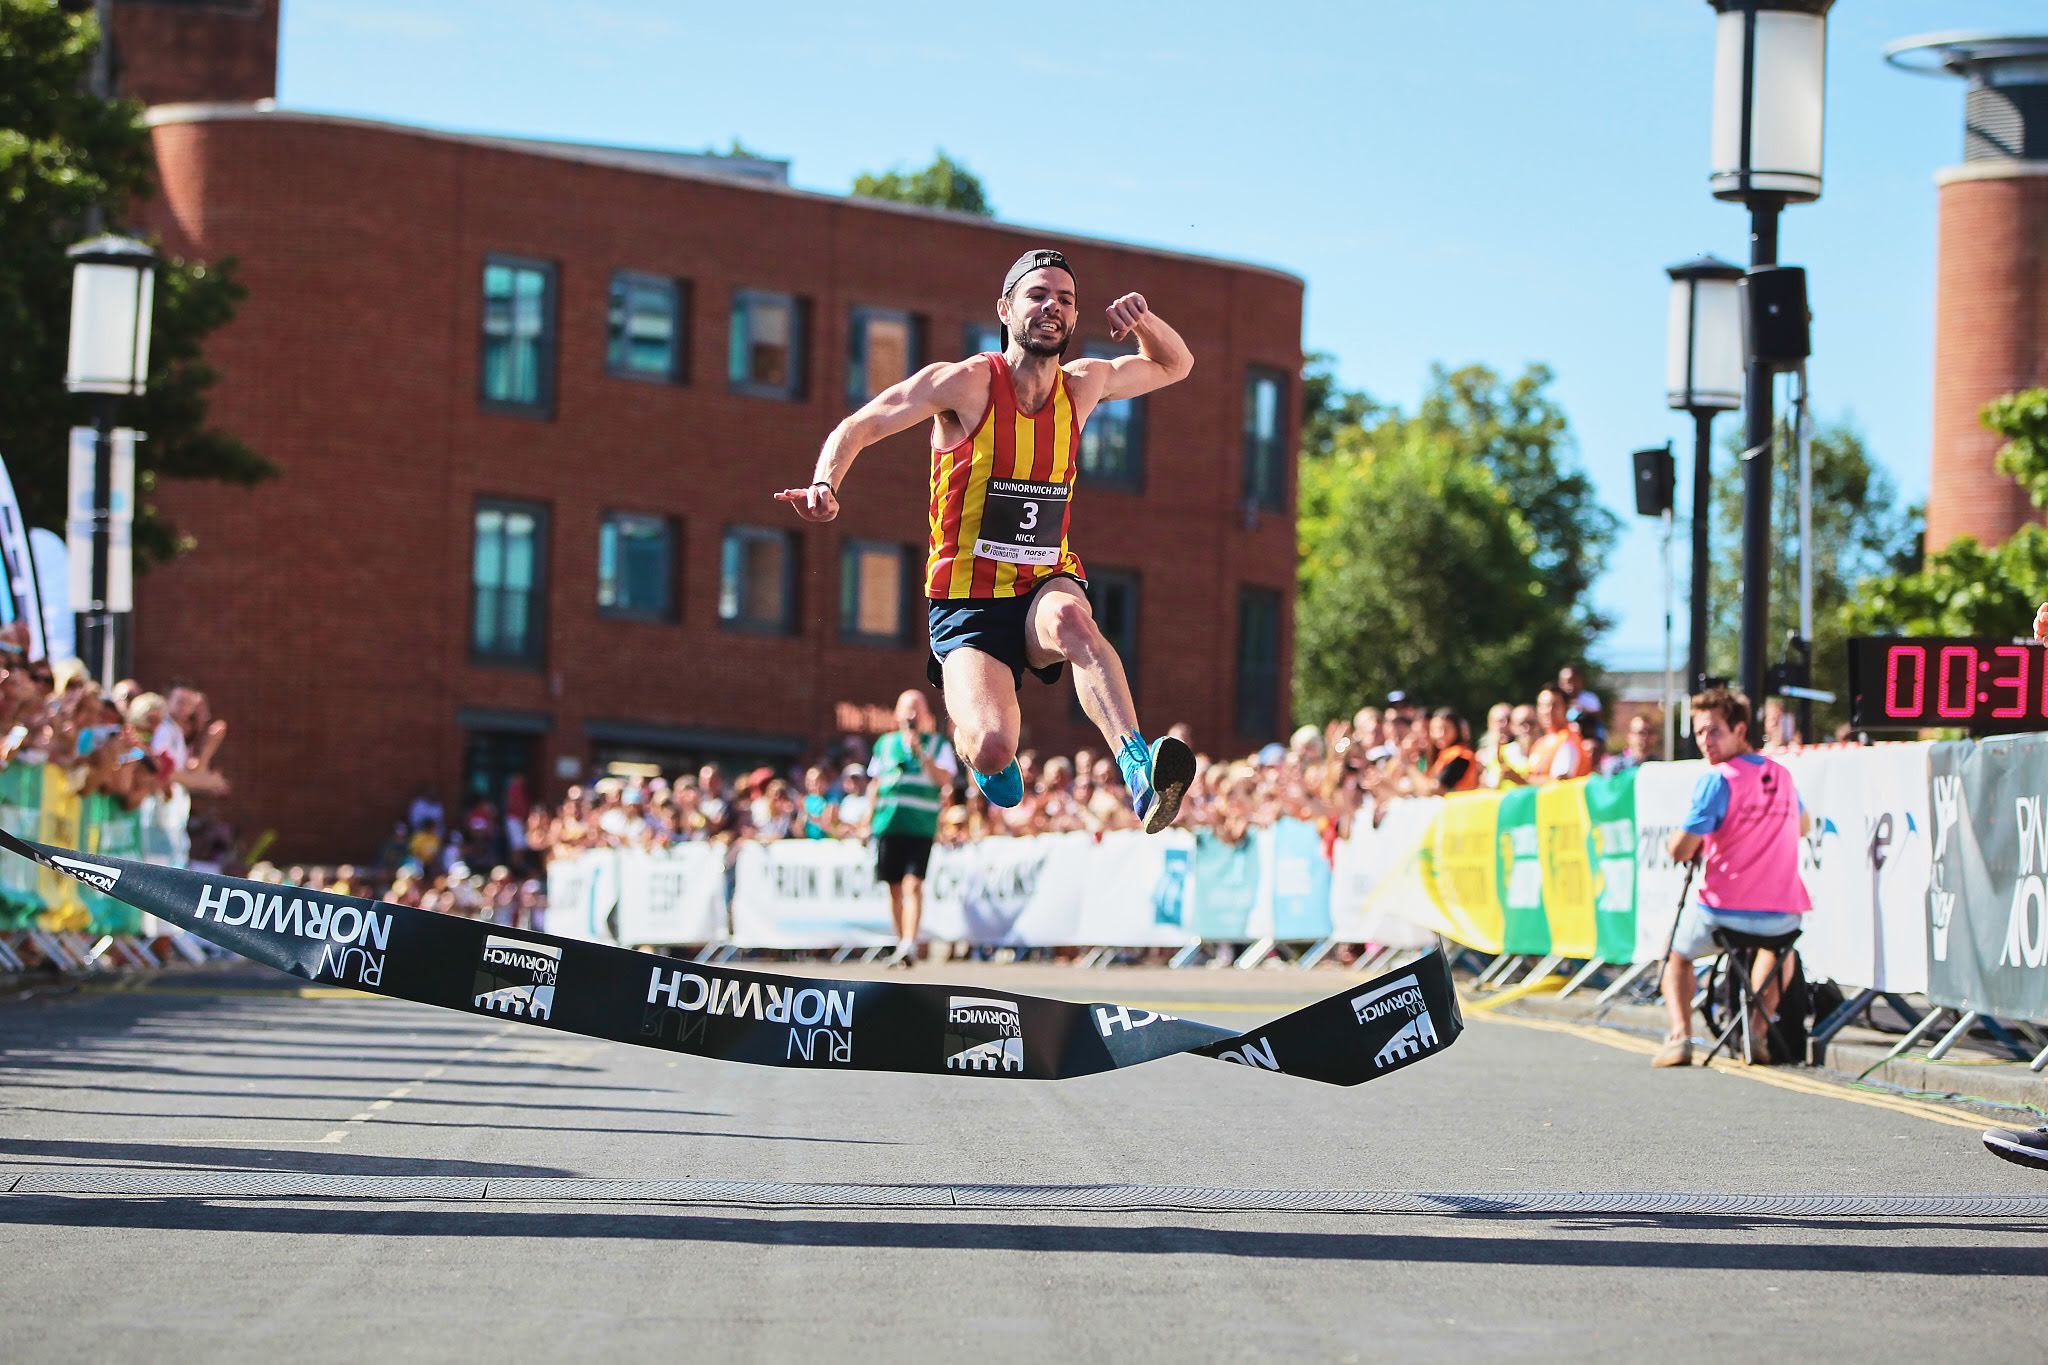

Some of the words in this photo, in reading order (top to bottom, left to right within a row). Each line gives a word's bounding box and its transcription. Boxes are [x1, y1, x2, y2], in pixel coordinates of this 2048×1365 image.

[992, 481, 1052, 495] RUNNORWICH
[1019, 501, 1039, 530] 3
[1015, 533, 1036, 543] NICK
[989, 548, 1019, 559] FOUNDATION
[1023, 548, 1047, 557] norse
[1885, 645, 2048, 718] 00:3
[193, 884, 393, 951] NORWICH
[317, 943, 386, 987] RUN
[483, 948, 559, 974] NORWICH
[532, 970, 557, 986] RUN
[646, 966, 855, 1028] NORWICH
[1355, 986, 1423, 1025] NORWICH
[1405, 999, 1427, 1017] RUN
[949, 1009, 1020, 1026] NORWICH
[999, 1024, 1021, 1037] RUN
[786, 1027, 853, 1063] RUN
